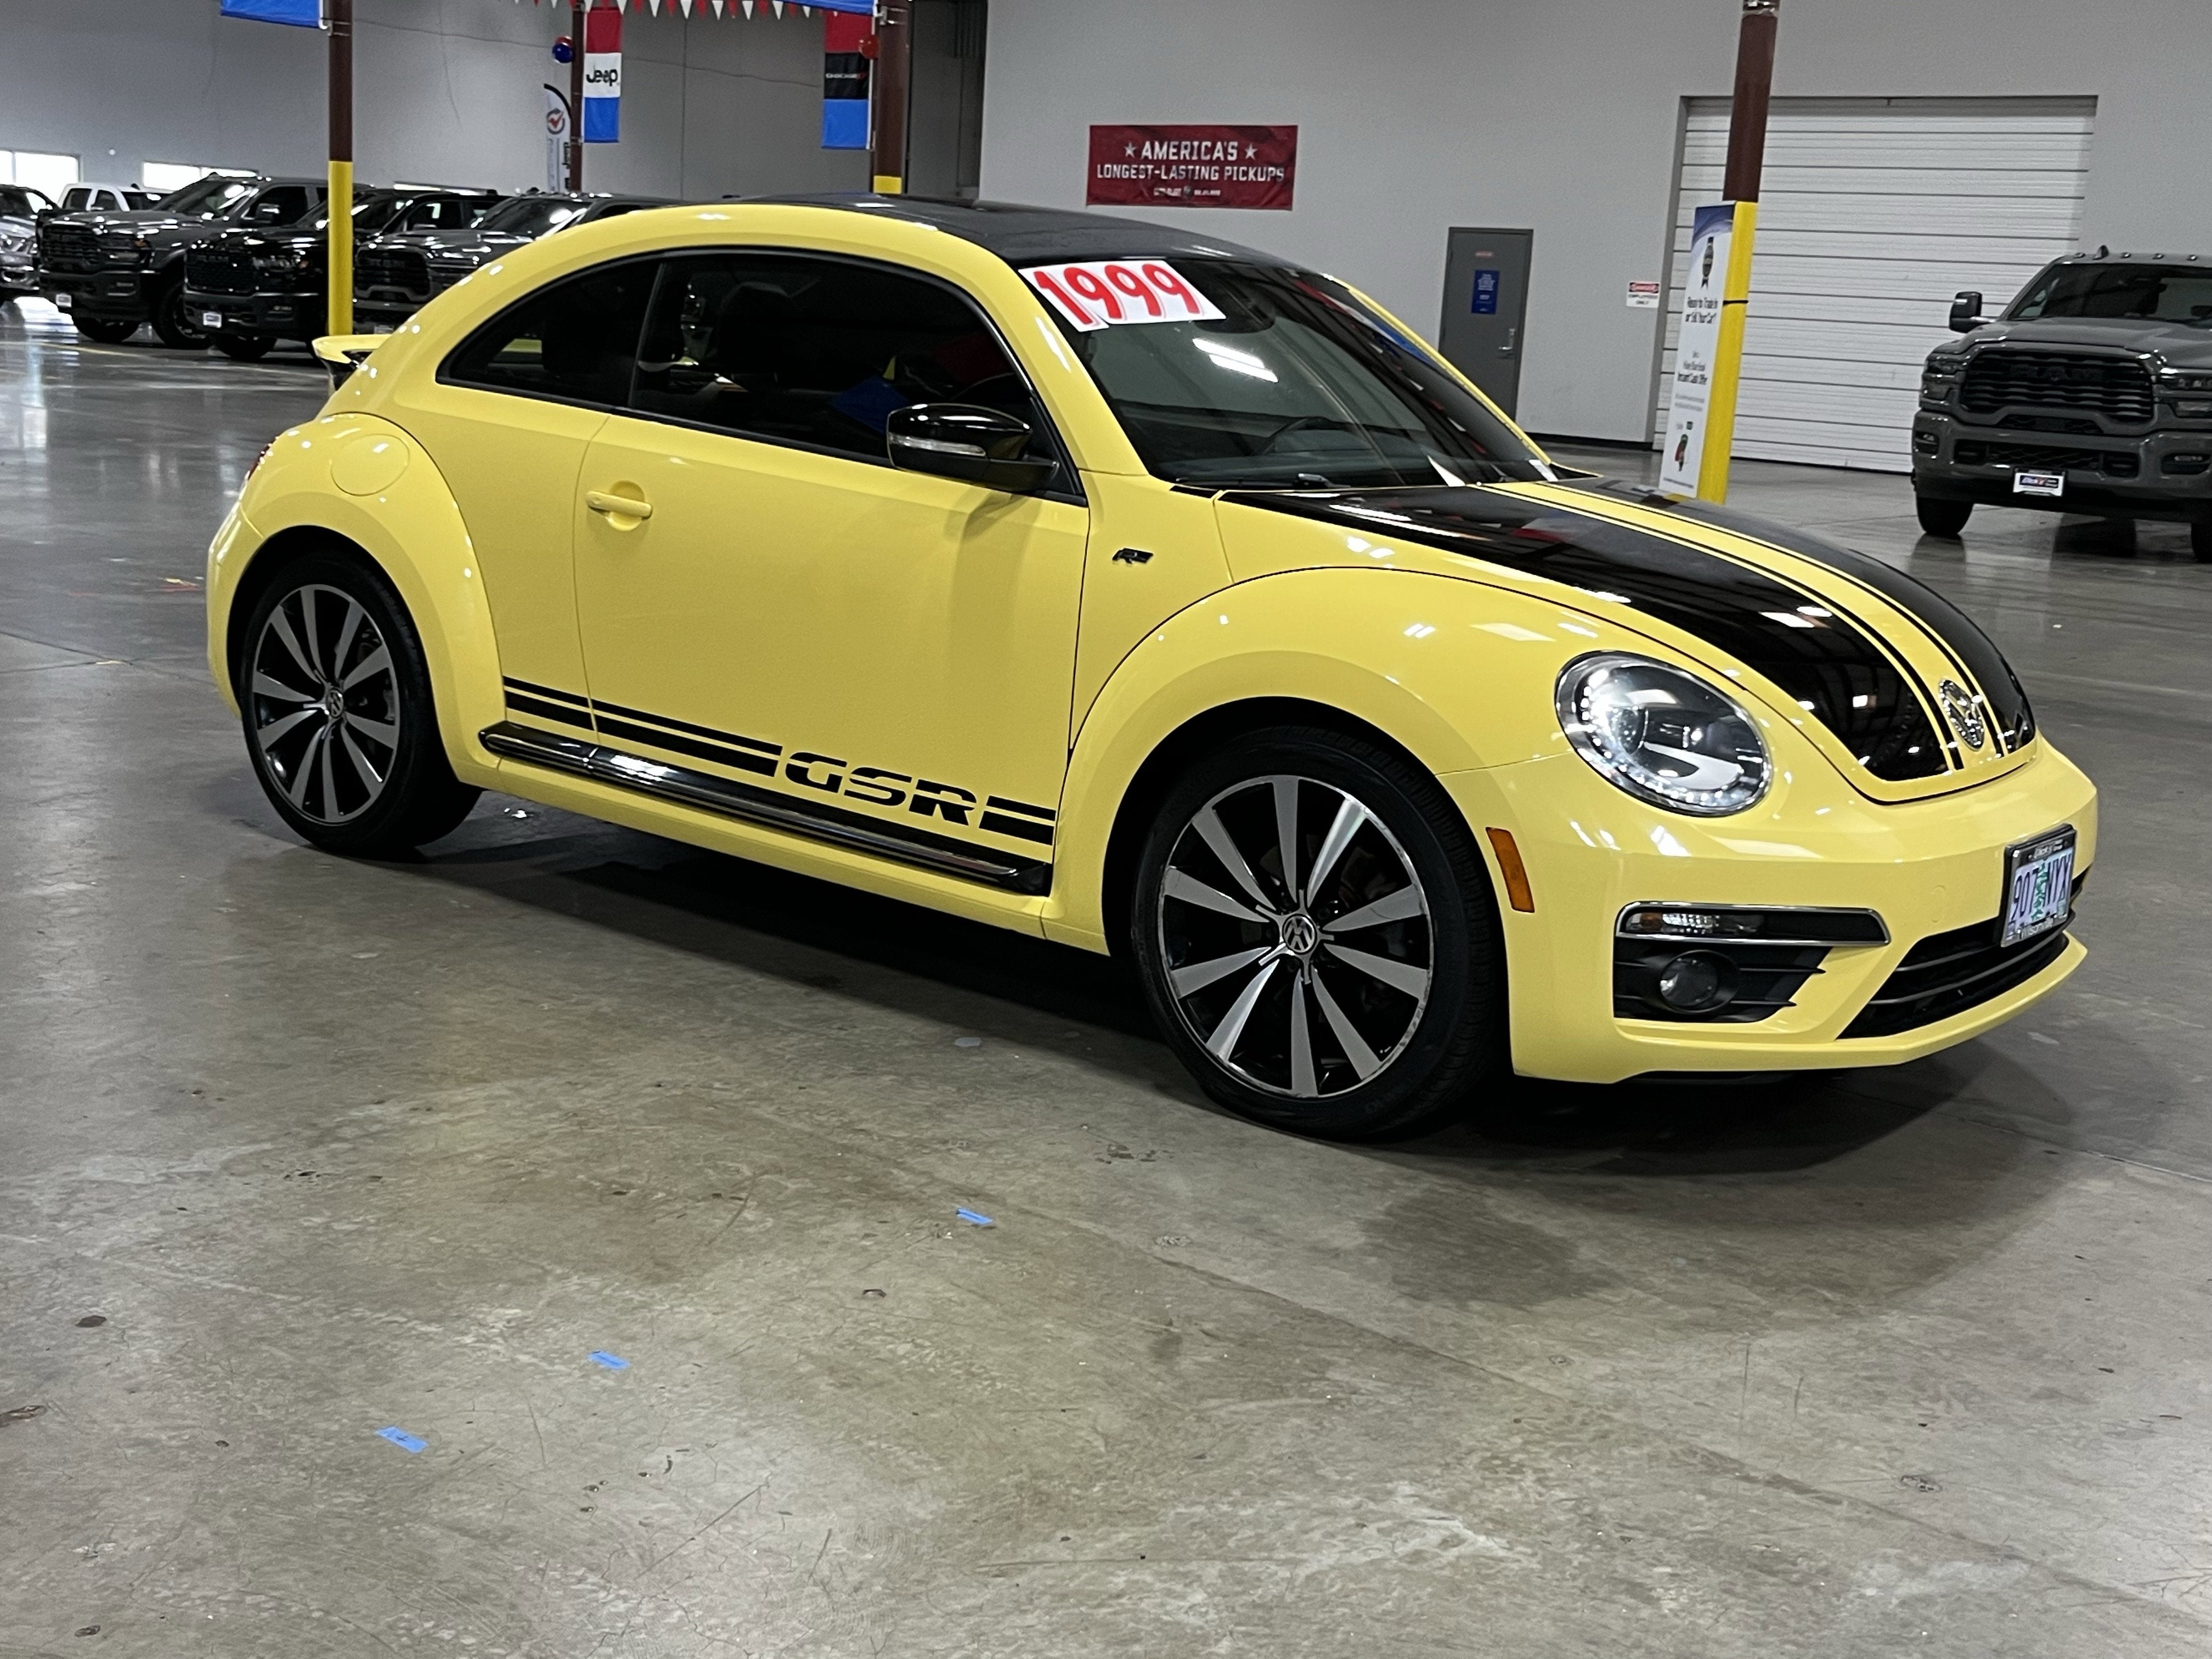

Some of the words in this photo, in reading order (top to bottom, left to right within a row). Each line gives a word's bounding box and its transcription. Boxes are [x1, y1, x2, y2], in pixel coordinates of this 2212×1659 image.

[586, 66, 618, 87] Jeep
[1141, 140, 1238, 161] AMERICA'S
[1097, 163, 1220, 181] LONGEST-LASTING
[1223, 166, 1285, 182] PICKUPS
[1032, 263, 1202, 325] 1999
[785, 752, 977, 826] GSR
[2011, 867, 2040, 921] 907
